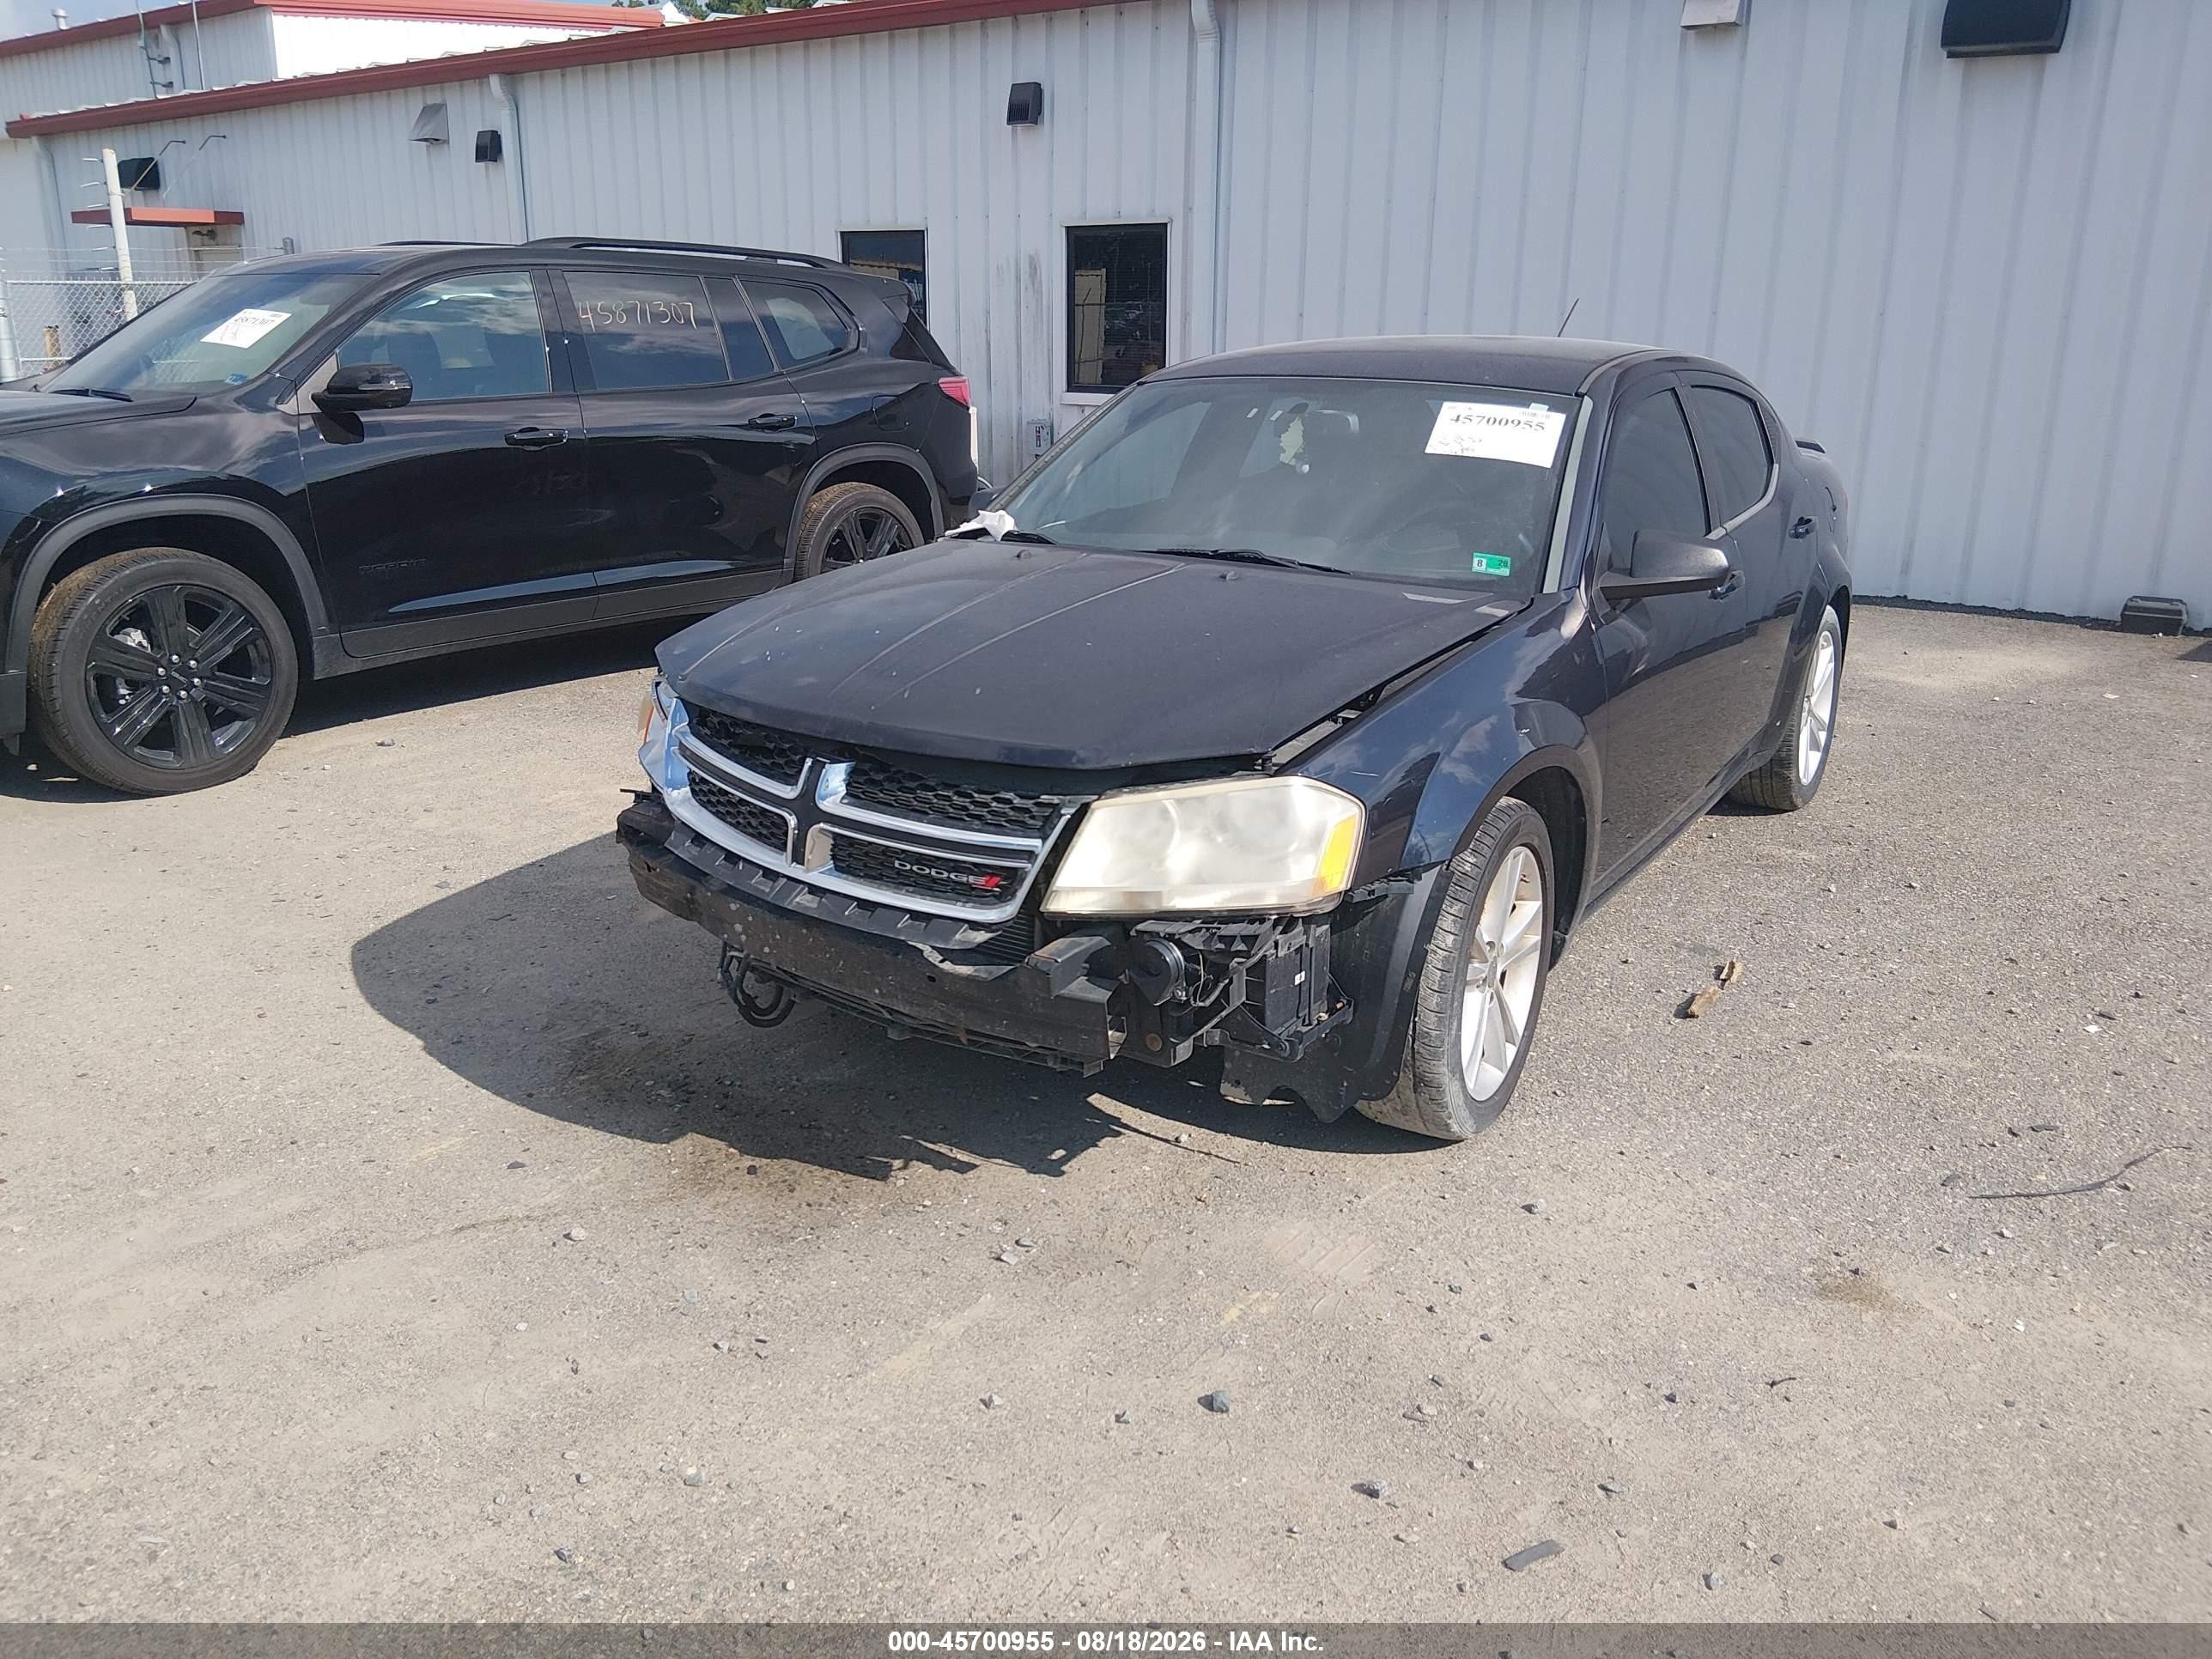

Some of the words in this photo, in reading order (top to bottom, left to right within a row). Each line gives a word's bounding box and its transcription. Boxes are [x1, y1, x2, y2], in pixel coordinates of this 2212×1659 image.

[577, 301, 697, 331] 45871307
[1449, 413, 1547, 432] 45700955
[1476, 559, 1484, 568] 8
[894, 860, 987, 885] DODGE
